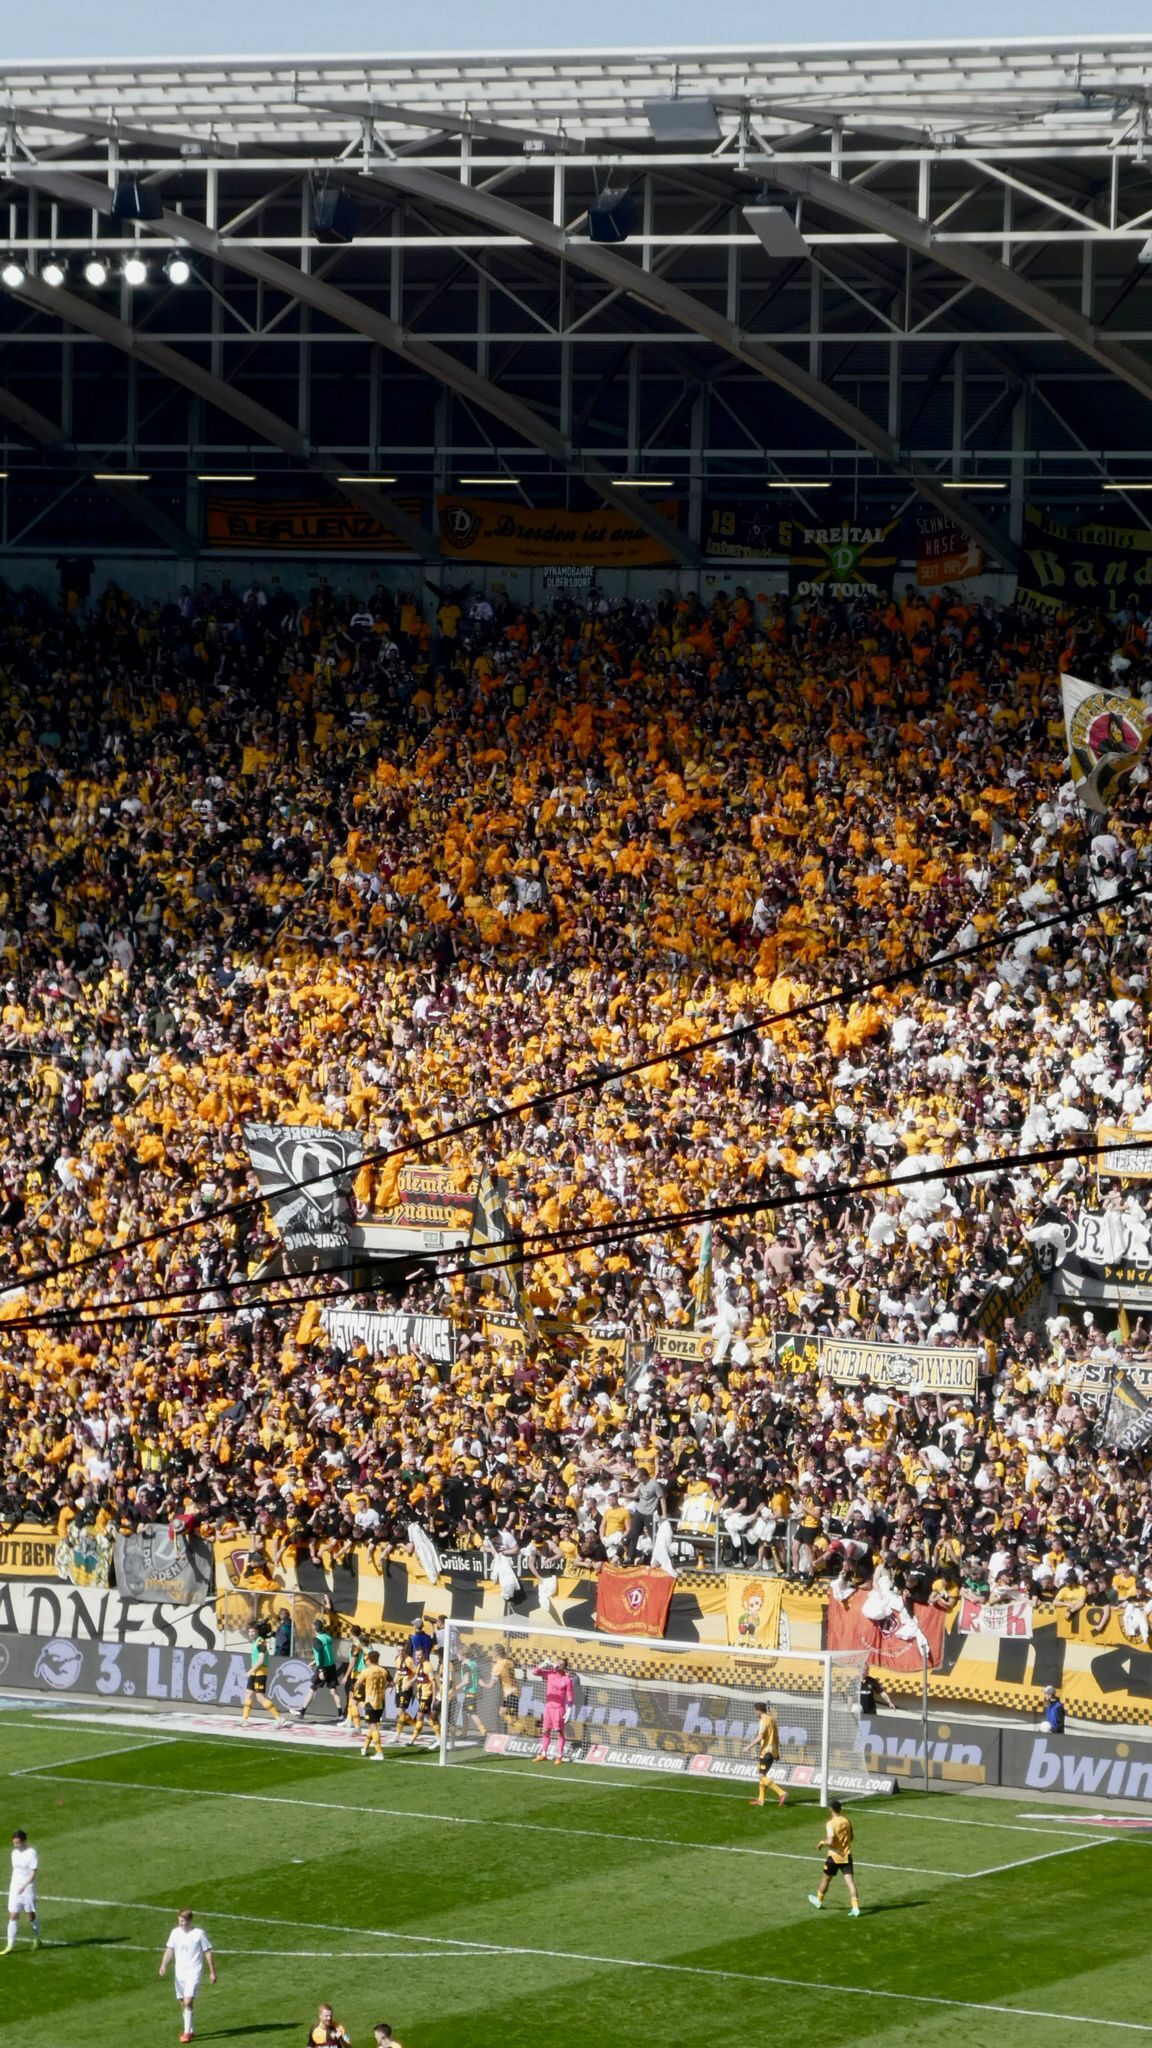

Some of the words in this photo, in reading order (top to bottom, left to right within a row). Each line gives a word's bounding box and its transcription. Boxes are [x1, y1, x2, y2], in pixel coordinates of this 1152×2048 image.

[711, 509, 736, 536] 19
[581, 524, 606, 541] ist
[803, 527, 885, 544] FREITAL
[926, 534, 957, 556] HASE
[797, 581, 824, 597] ON
[829, 583, 878, 599] TOUR
[659, 1336, 696, 1353] Forza
[826, 1348, 889, 1382] OSTBLOCK
[915, 1357, 974, 1386] DYNAMO
[439, 1553, 471, 1571] Grüße
[472, 1557, 482, 1572] in
[96, 1643, 136, 1696] 3.
[147, 1646, 248, 1705] LIGA
